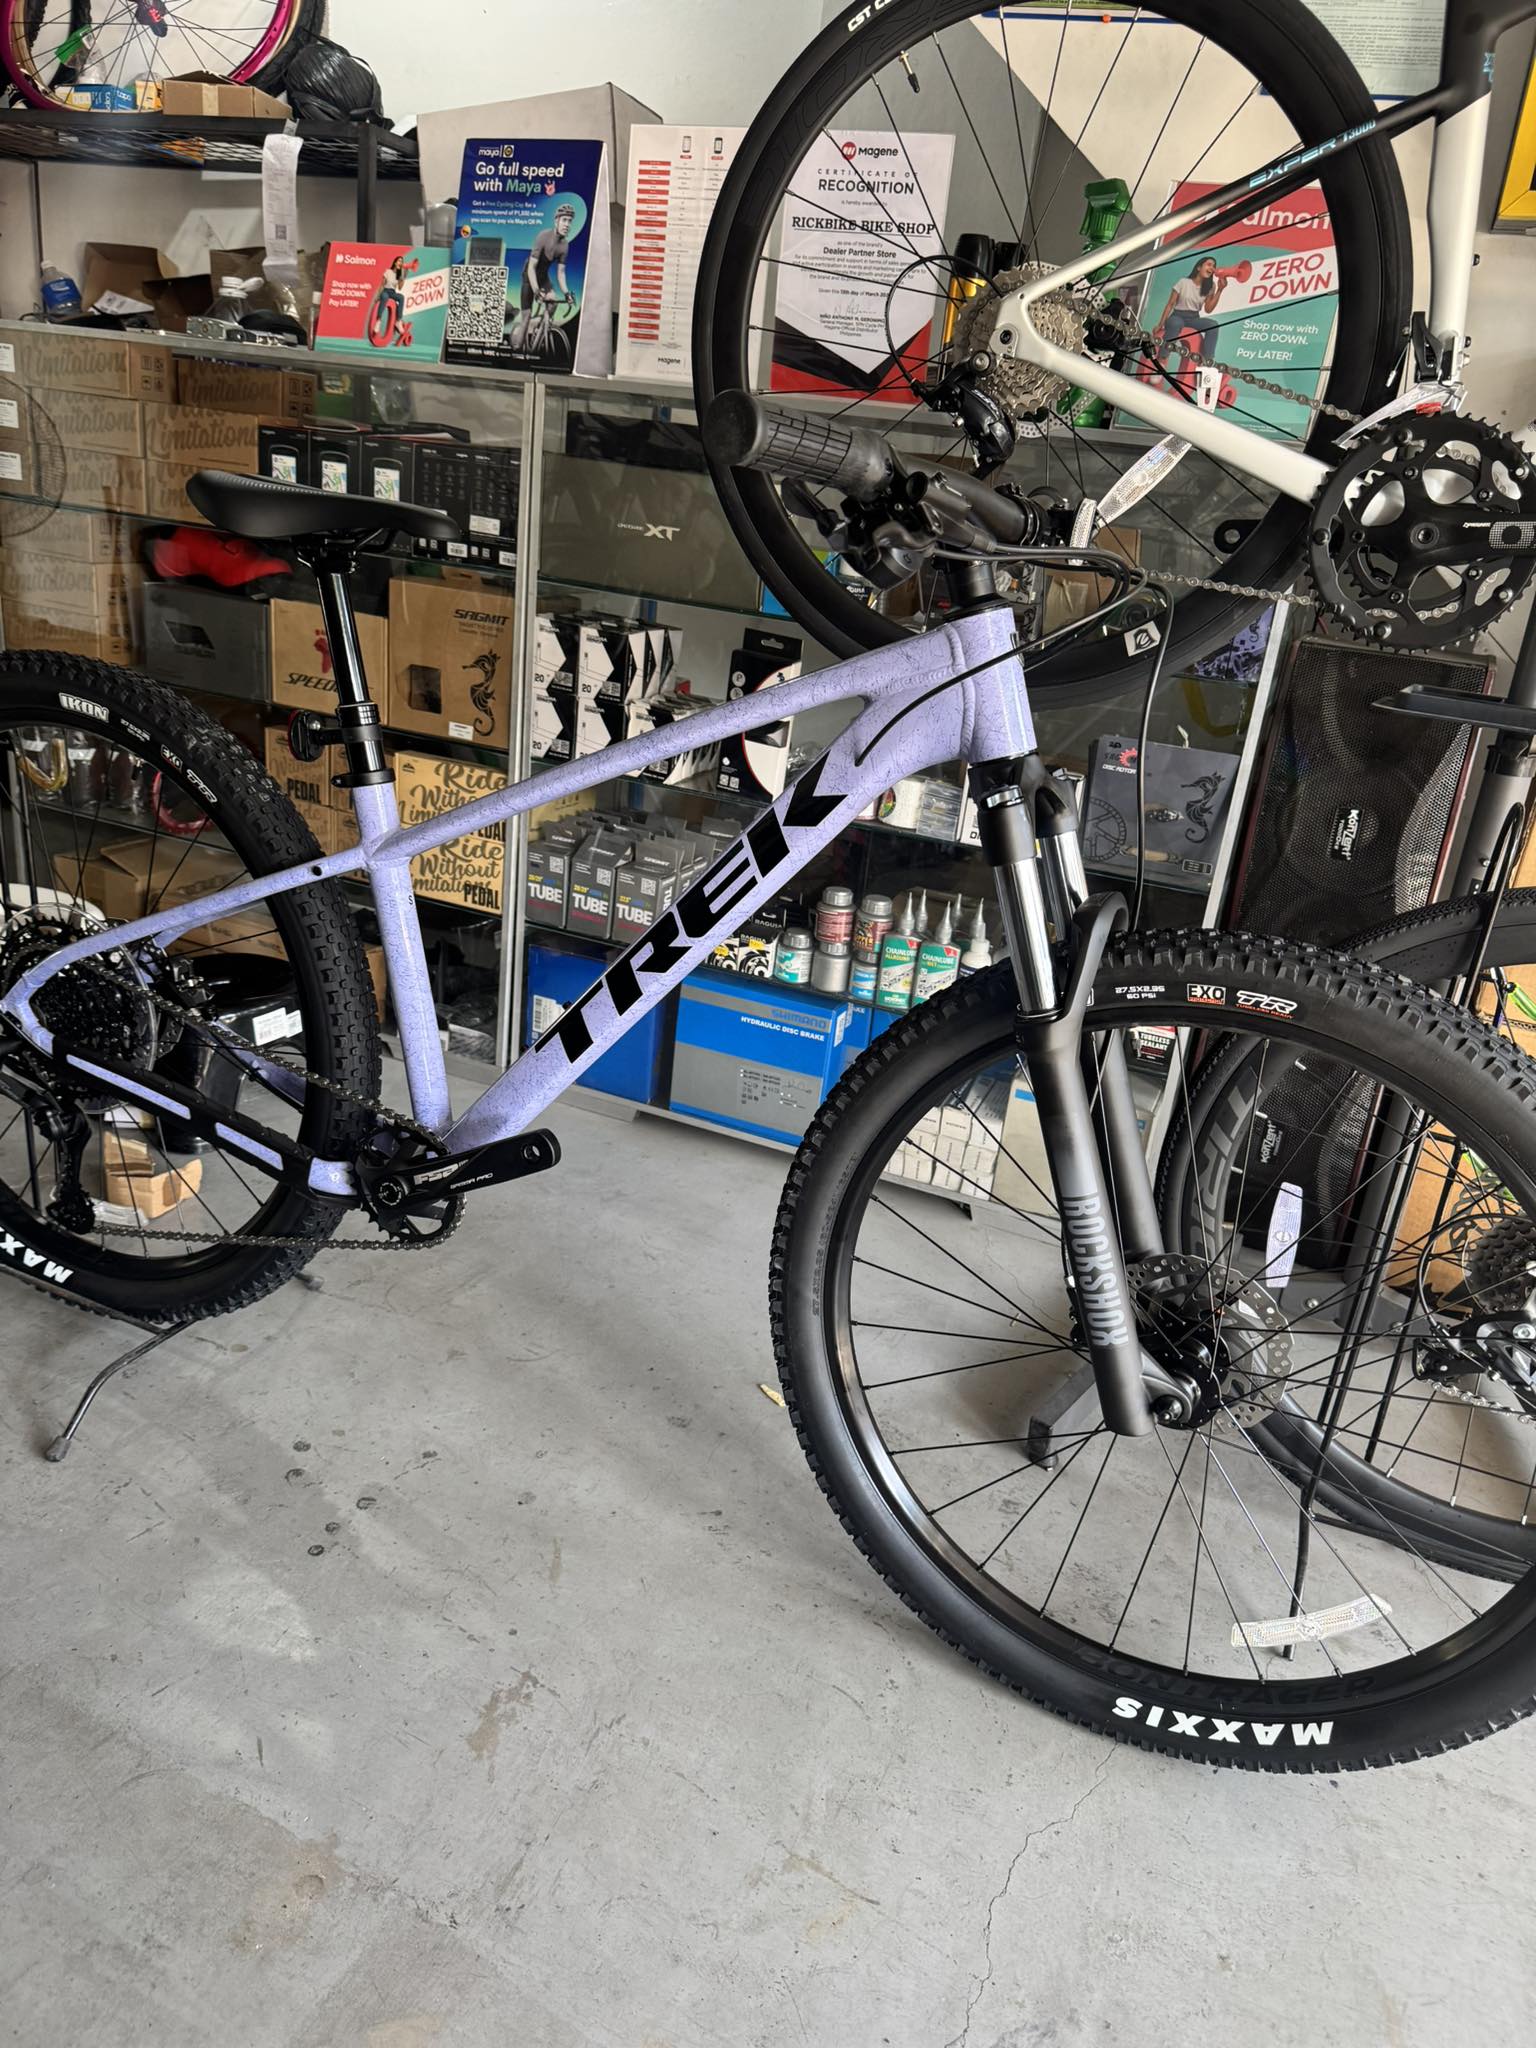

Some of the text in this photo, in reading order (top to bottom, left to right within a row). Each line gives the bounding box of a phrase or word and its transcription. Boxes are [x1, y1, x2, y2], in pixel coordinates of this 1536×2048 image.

[847, 5, 872, 32] CST
[858, 147, 899, 159] Magene
[476, 162, 565, 181] Go full speed
[474, 178, 542, 196] with Maya
[818, 178, 914, 195] RECOGNITION
[791, 216, 936, 235] RICKBIKE BIKE SHOP
[344, 254, 377, 266] Salmon
[823, 246, 896, 258] Dealer Partner Store
[1259, 253, 1325, 282] ZERO
[412, 275, 443, 294] ZERO
[1249, 271, 1333, 305] DOWN
[405, 288, 446, 309] DOWN
[1243, 320, 1319, 336] Shop now with
[1240, 331, 1309, 346] ZERO DOWN.
[1236, 347, 1293, 362] Pay LATER!
[644, 522, 681, 542] XT
[452, 608, 511, 627] SAGMIT
[534, 672, 545, 684] 20
[582, 682, 592, 694] 20
[58, 692, 110, 724] IKON
[532, 740, 543, 750] 20
[434, 760, 509, 794] Ride
[410, 853, 501, 879] Without
[408, 895, 414, 905] S
[463, 882, 501, 910] PEDAL
[527, 882, 563, 905] TUBE
[534, 749, 849, 1065] TREK
[572, 892, 609, 917] TUBE
[616, 902, 654, 926] TUBE
[1188, 984, 1226, 1001] EXO
[1236, 990, 1298, 1016] TR
[740, 1015, 825, 1042] HYDRAULIC DISC BRAKE
[771, 1007, 828, 1031] SHIMANO
[1139, 1032, 1171, 1045] TUBELESS
[1063, 1194, 1130, 1347] ROCKSHOX
[1110, 1695, 1335, 1747] MAXXIS
